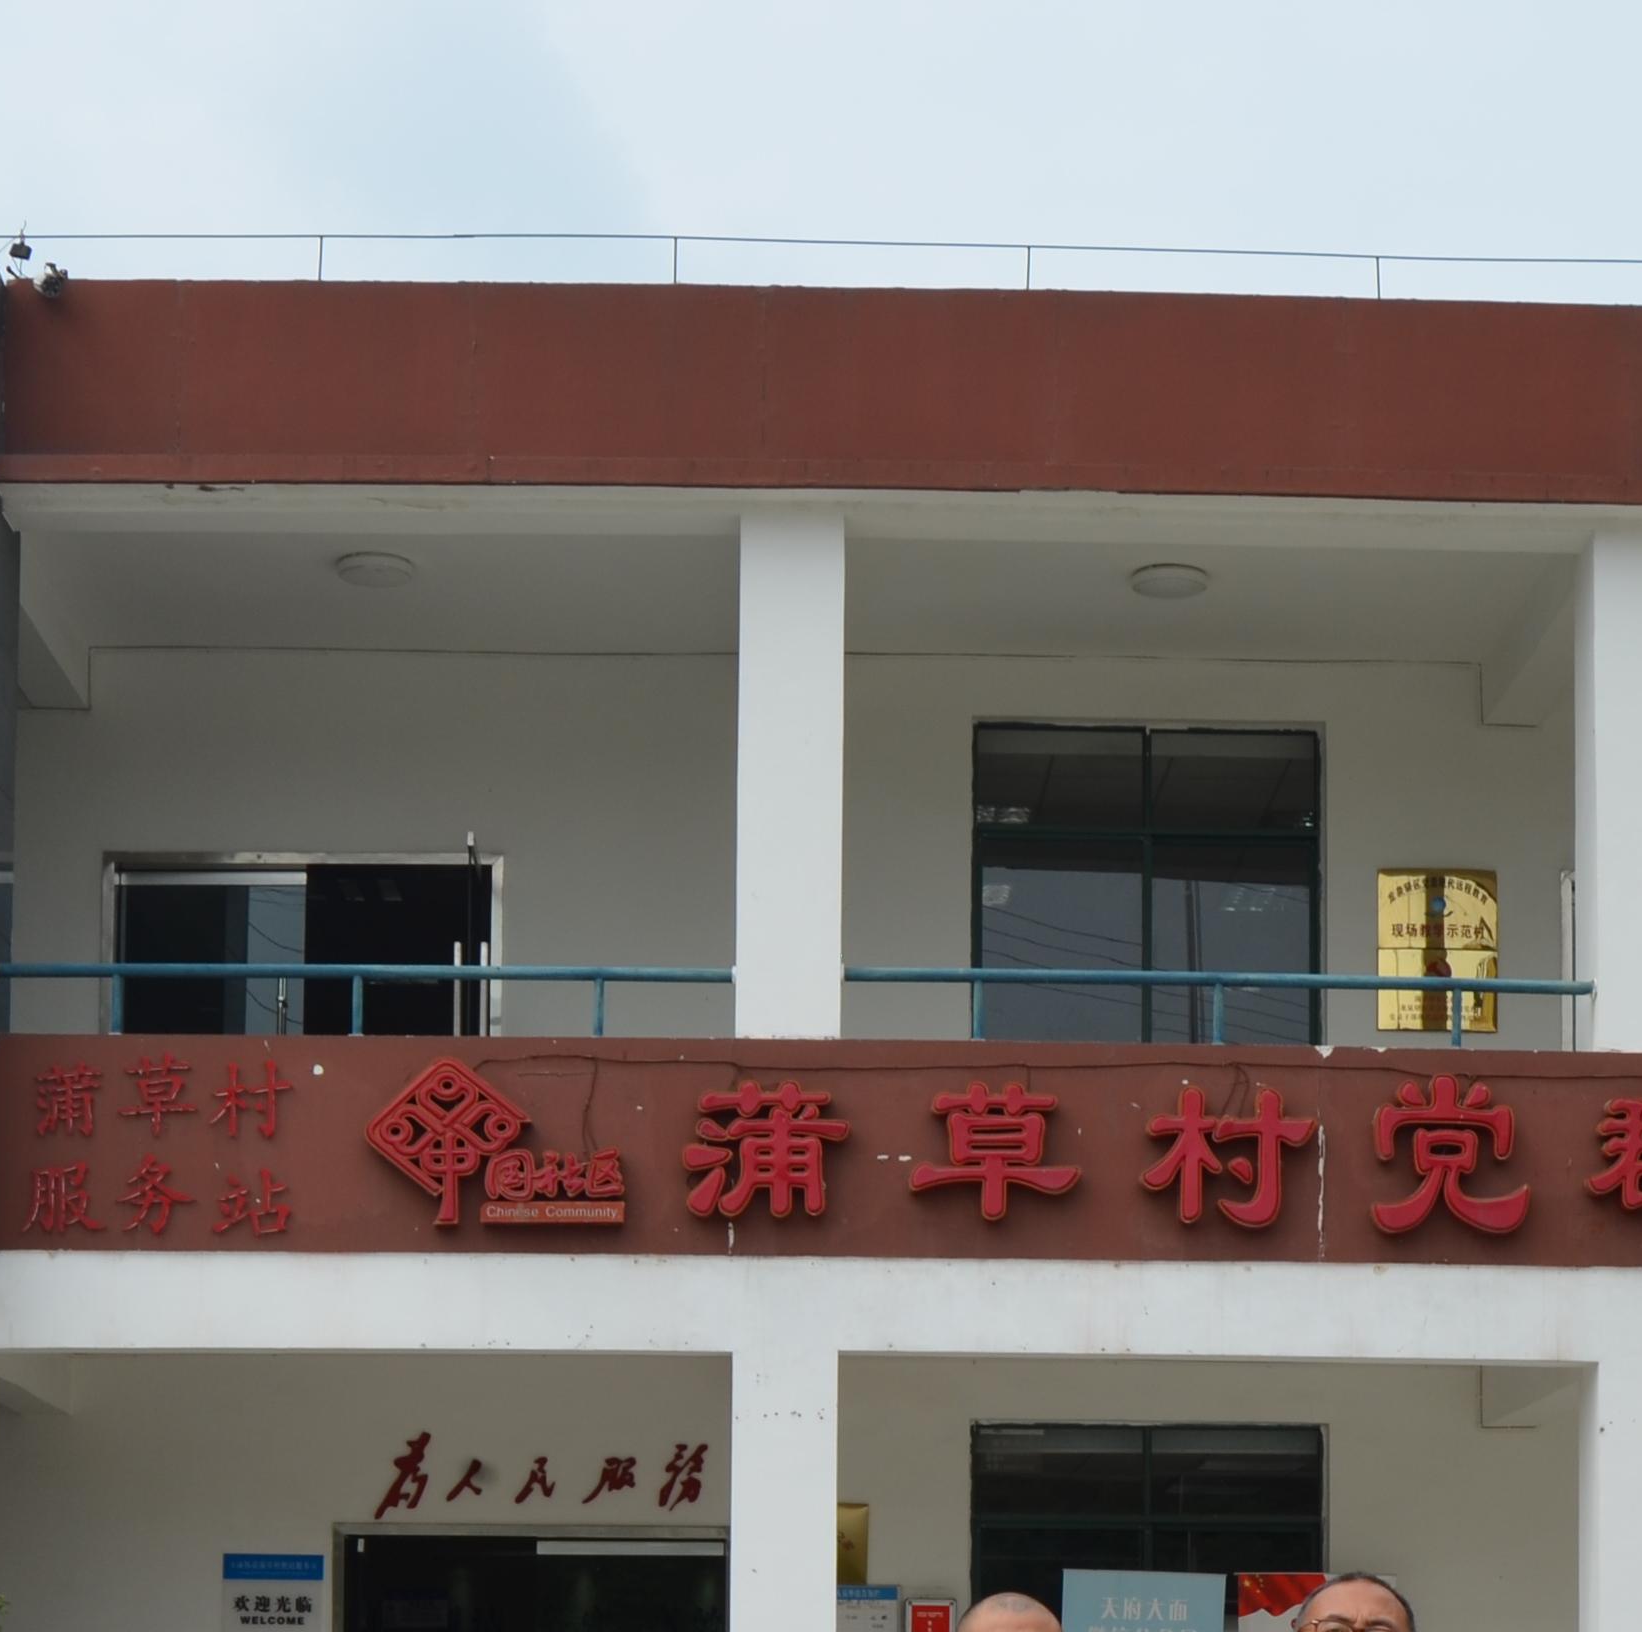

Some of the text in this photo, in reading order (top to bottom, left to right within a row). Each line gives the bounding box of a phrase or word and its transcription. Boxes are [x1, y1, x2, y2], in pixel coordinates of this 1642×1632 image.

[35, 1055, 295, 1140] 蒲草村
[22, 1153, 292, 1236] 服务站
[486, 1205, 619, 1220] Chinese Community
[234, 1595, 312, 1613] 欢迎光临
[1100, 1597, 1189, 1621] 天府大面
[240, 1615, 305, 1625] WELCOME
